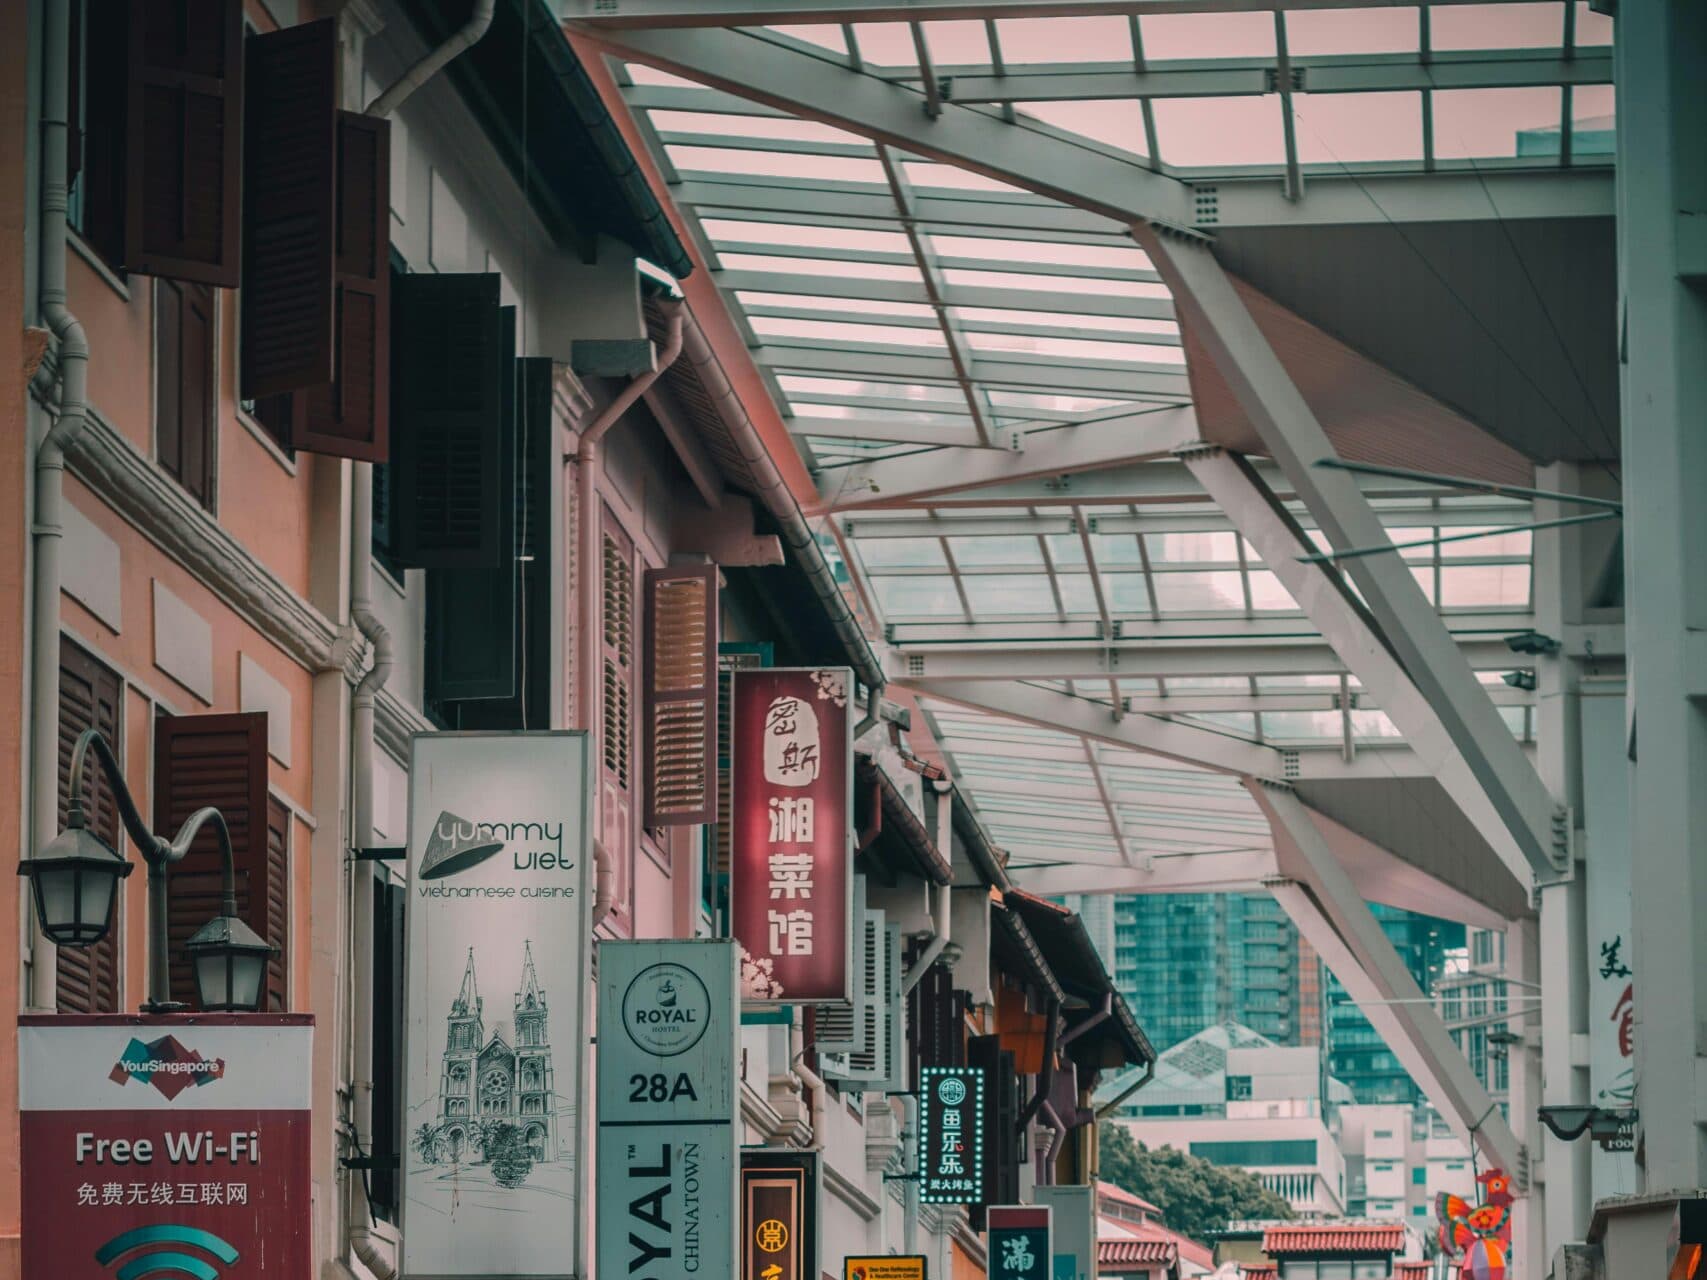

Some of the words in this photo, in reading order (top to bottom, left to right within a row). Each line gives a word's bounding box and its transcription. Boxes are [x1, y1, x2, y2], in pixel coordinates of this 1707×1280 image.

[438, 822, 562, 850] yummy
[418, 880, 516, 898] vietnamese
[520, 887, 575, 898] cuisine
[768, 796, 814, 956] 湘菜馆
[636, 1009, 696, 1024] ROYAL
[121, 1059, 220, 1075] YourSingapore
[629, 1072, 698, 1102] 28A
[76, 1132, 153, 1163] Free
[164, 1130, 258, 1163] Wi-Fi
[77, 1182, 248, 1206] 免费无线互联网
[684, 1142, 700, 1273] CHINATOWN
